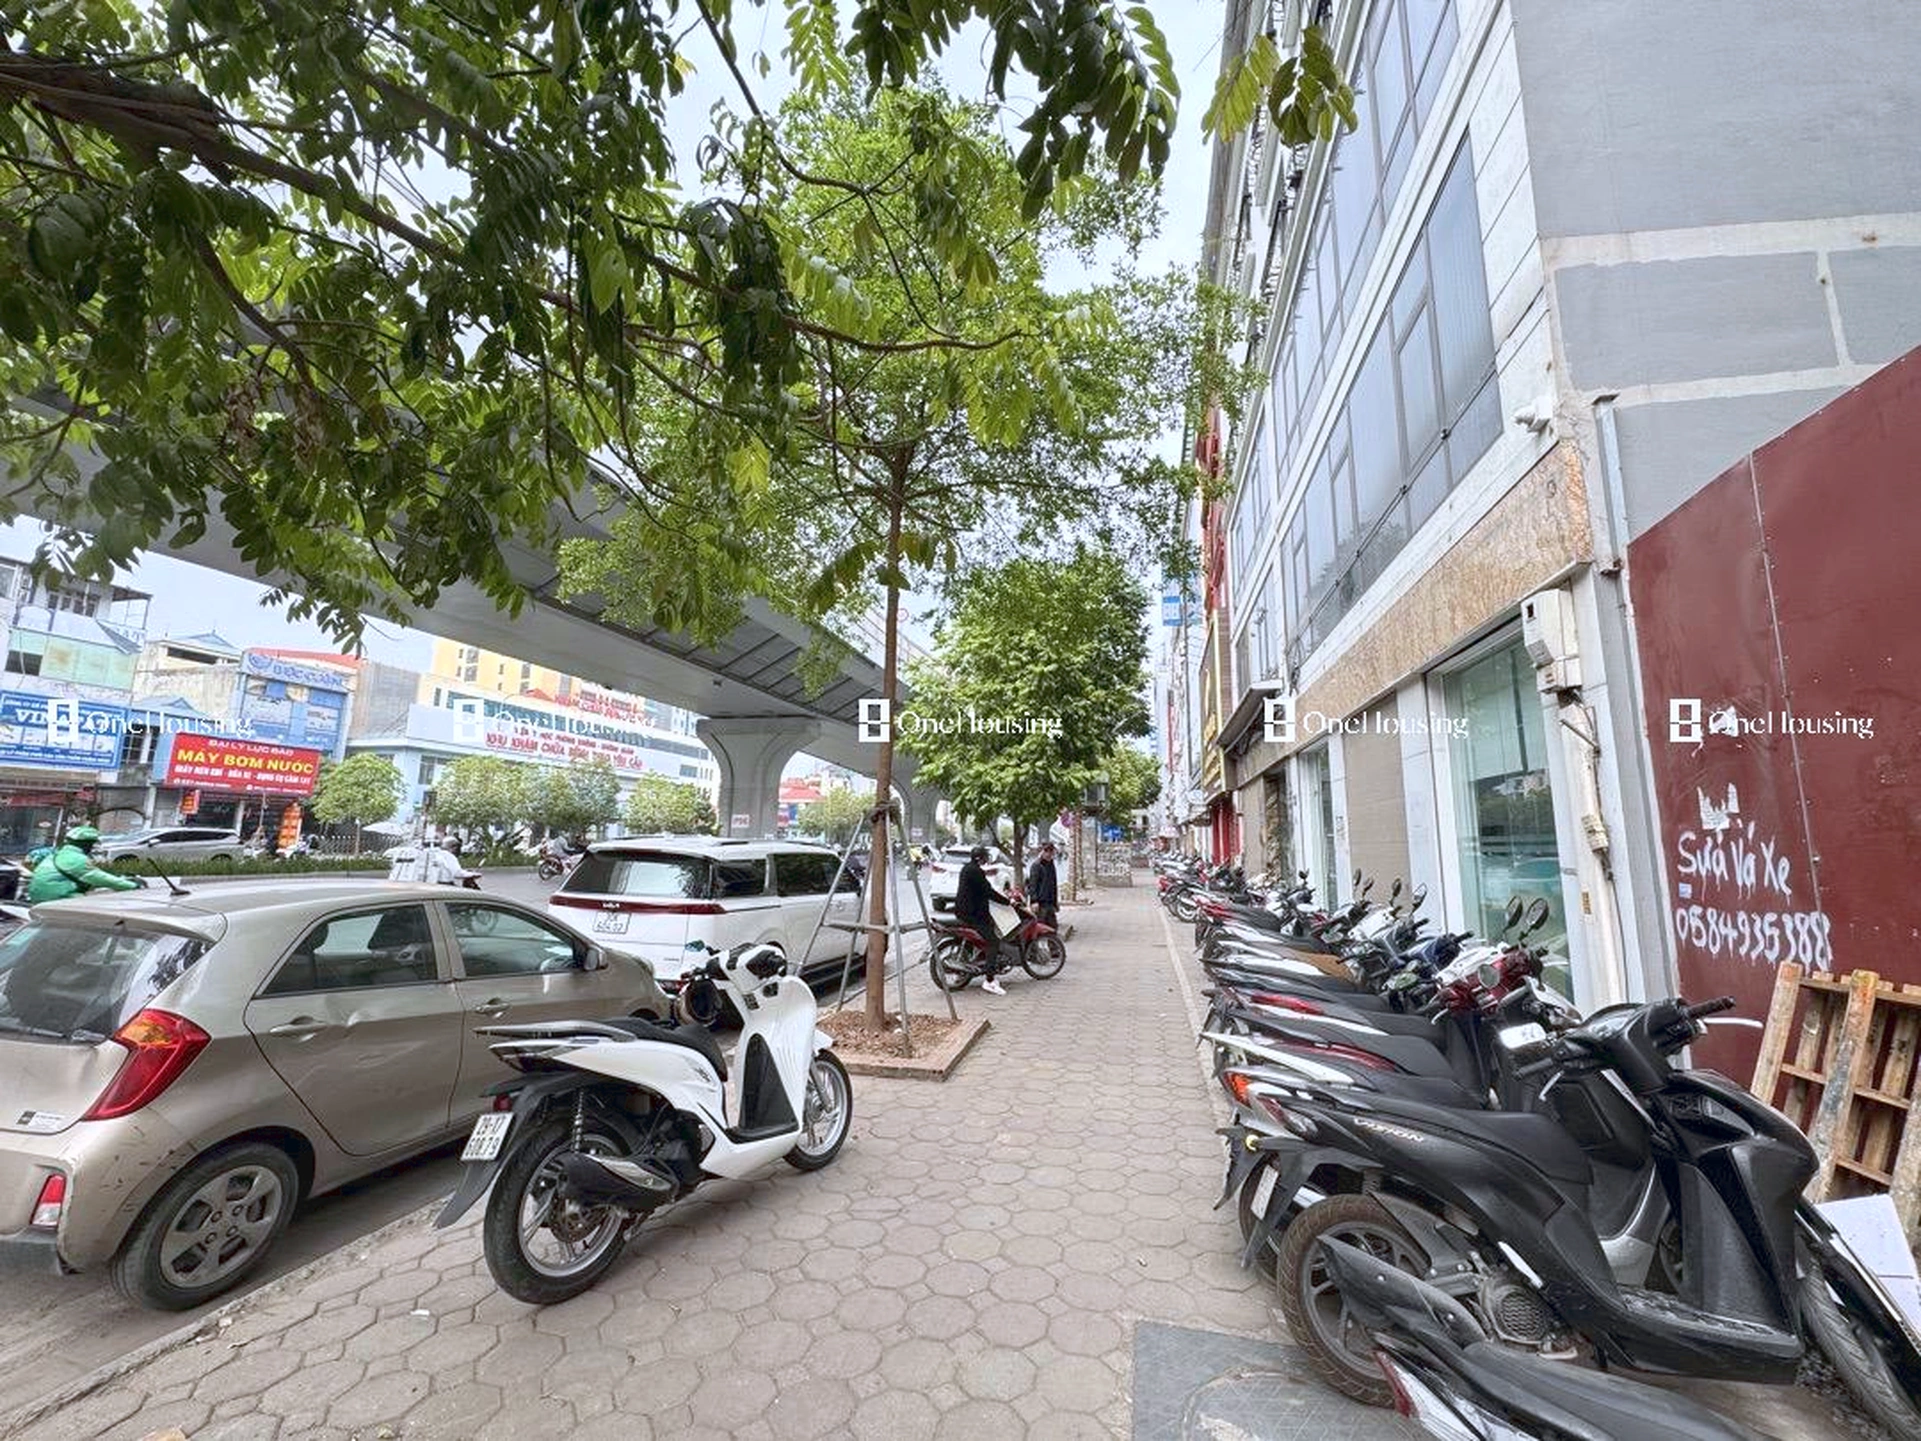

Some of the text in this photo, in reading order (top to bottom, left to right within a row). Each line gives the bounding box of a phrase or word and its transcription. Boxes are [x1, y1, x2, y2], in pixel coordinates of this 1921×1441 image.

[177, 748, 314, 774] MÁY BƠM NƯỚC
